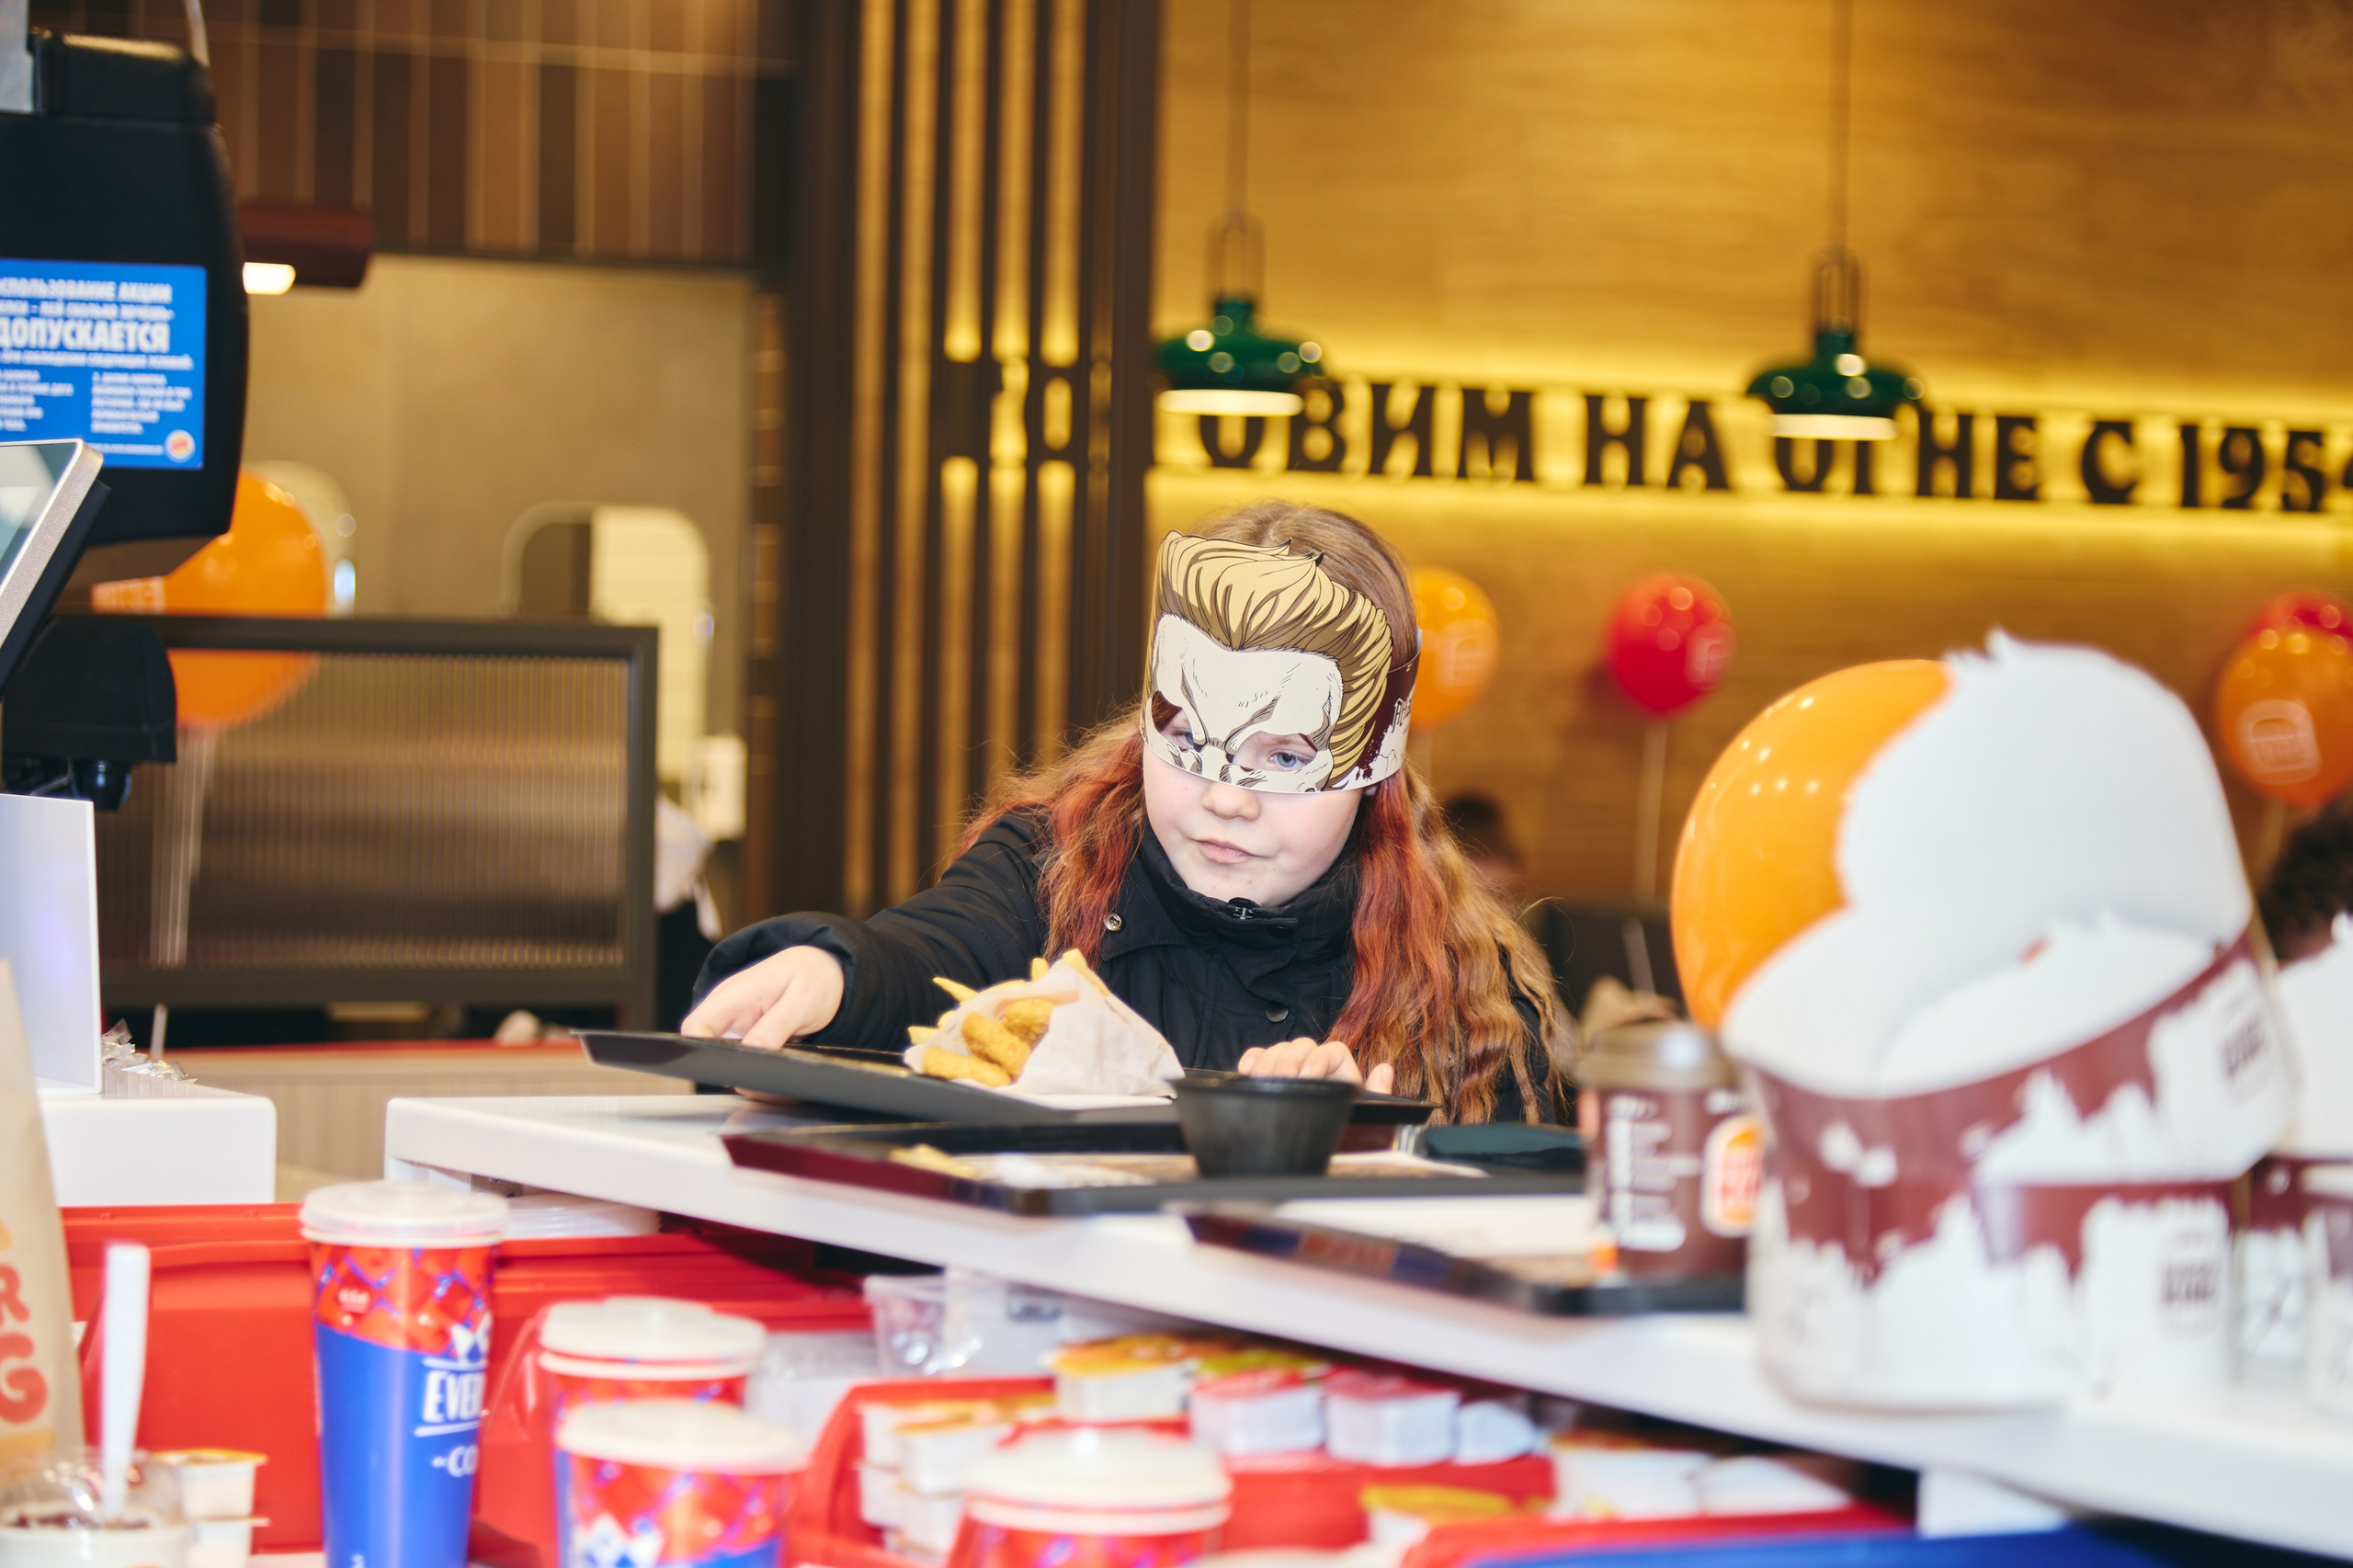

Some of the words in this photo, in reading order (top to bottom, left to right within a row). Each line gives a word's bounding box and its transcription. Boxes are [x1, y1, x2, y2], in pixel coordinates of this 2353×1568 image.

[1584, 393, 1728, 490] НА
[2082, 420, 2136, 505] С
[2179, 424, 2353, 512] 195
